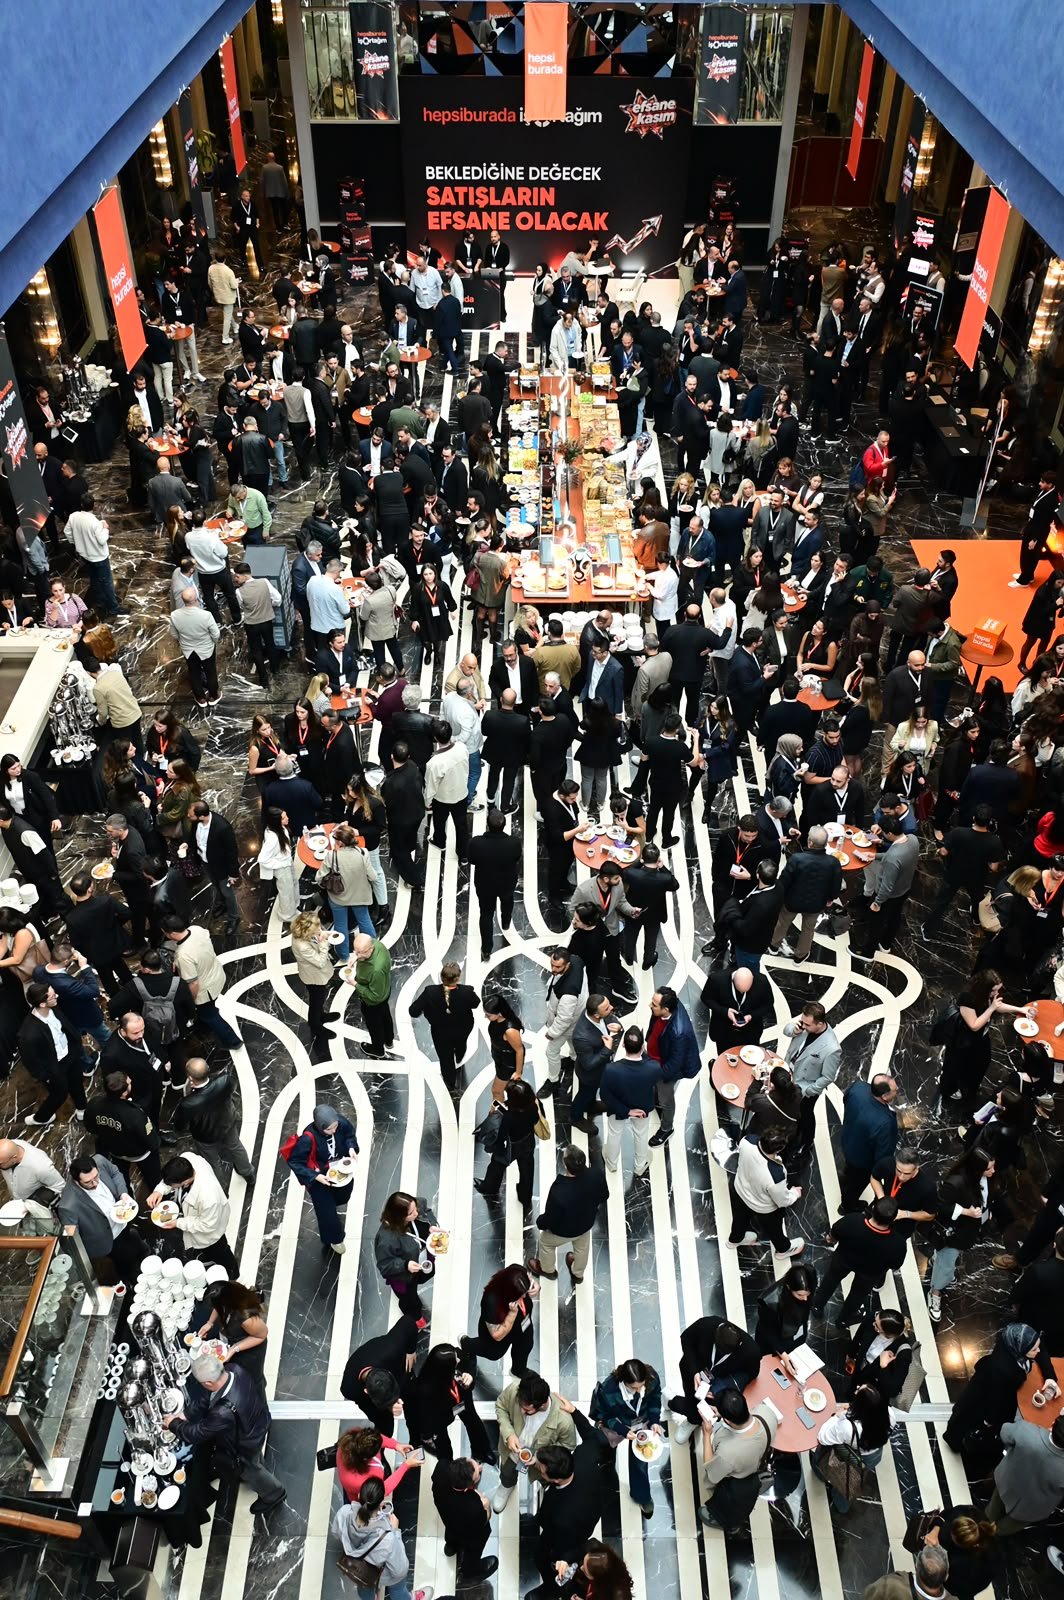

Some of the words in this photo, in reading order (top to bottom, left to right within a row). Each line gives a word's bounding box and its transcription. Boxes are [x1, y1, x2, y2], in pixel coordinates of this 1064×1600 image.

[527, 52, 556, 64] hepsi
[527, 64, 564, 75] burada
[632, 99, 676, 113] efsane
[423, 107, 516, 125] hepsiburada
[519, 107, 603, 128] iağım
[637, 112, 676, 125] kasım
[425, 163, 524, 180] BEKLEDİĞİNE
[529, 163, 602, 181] DEĞECEK
[426, 186, 555, 208] SATIŞLARIN
[427, 211, 510, 231] EFSANE
[515, 211, 609, 231] OLACAK
[110, 263, 127, 290] hepsi
[113, 278, 134, 307] burada
